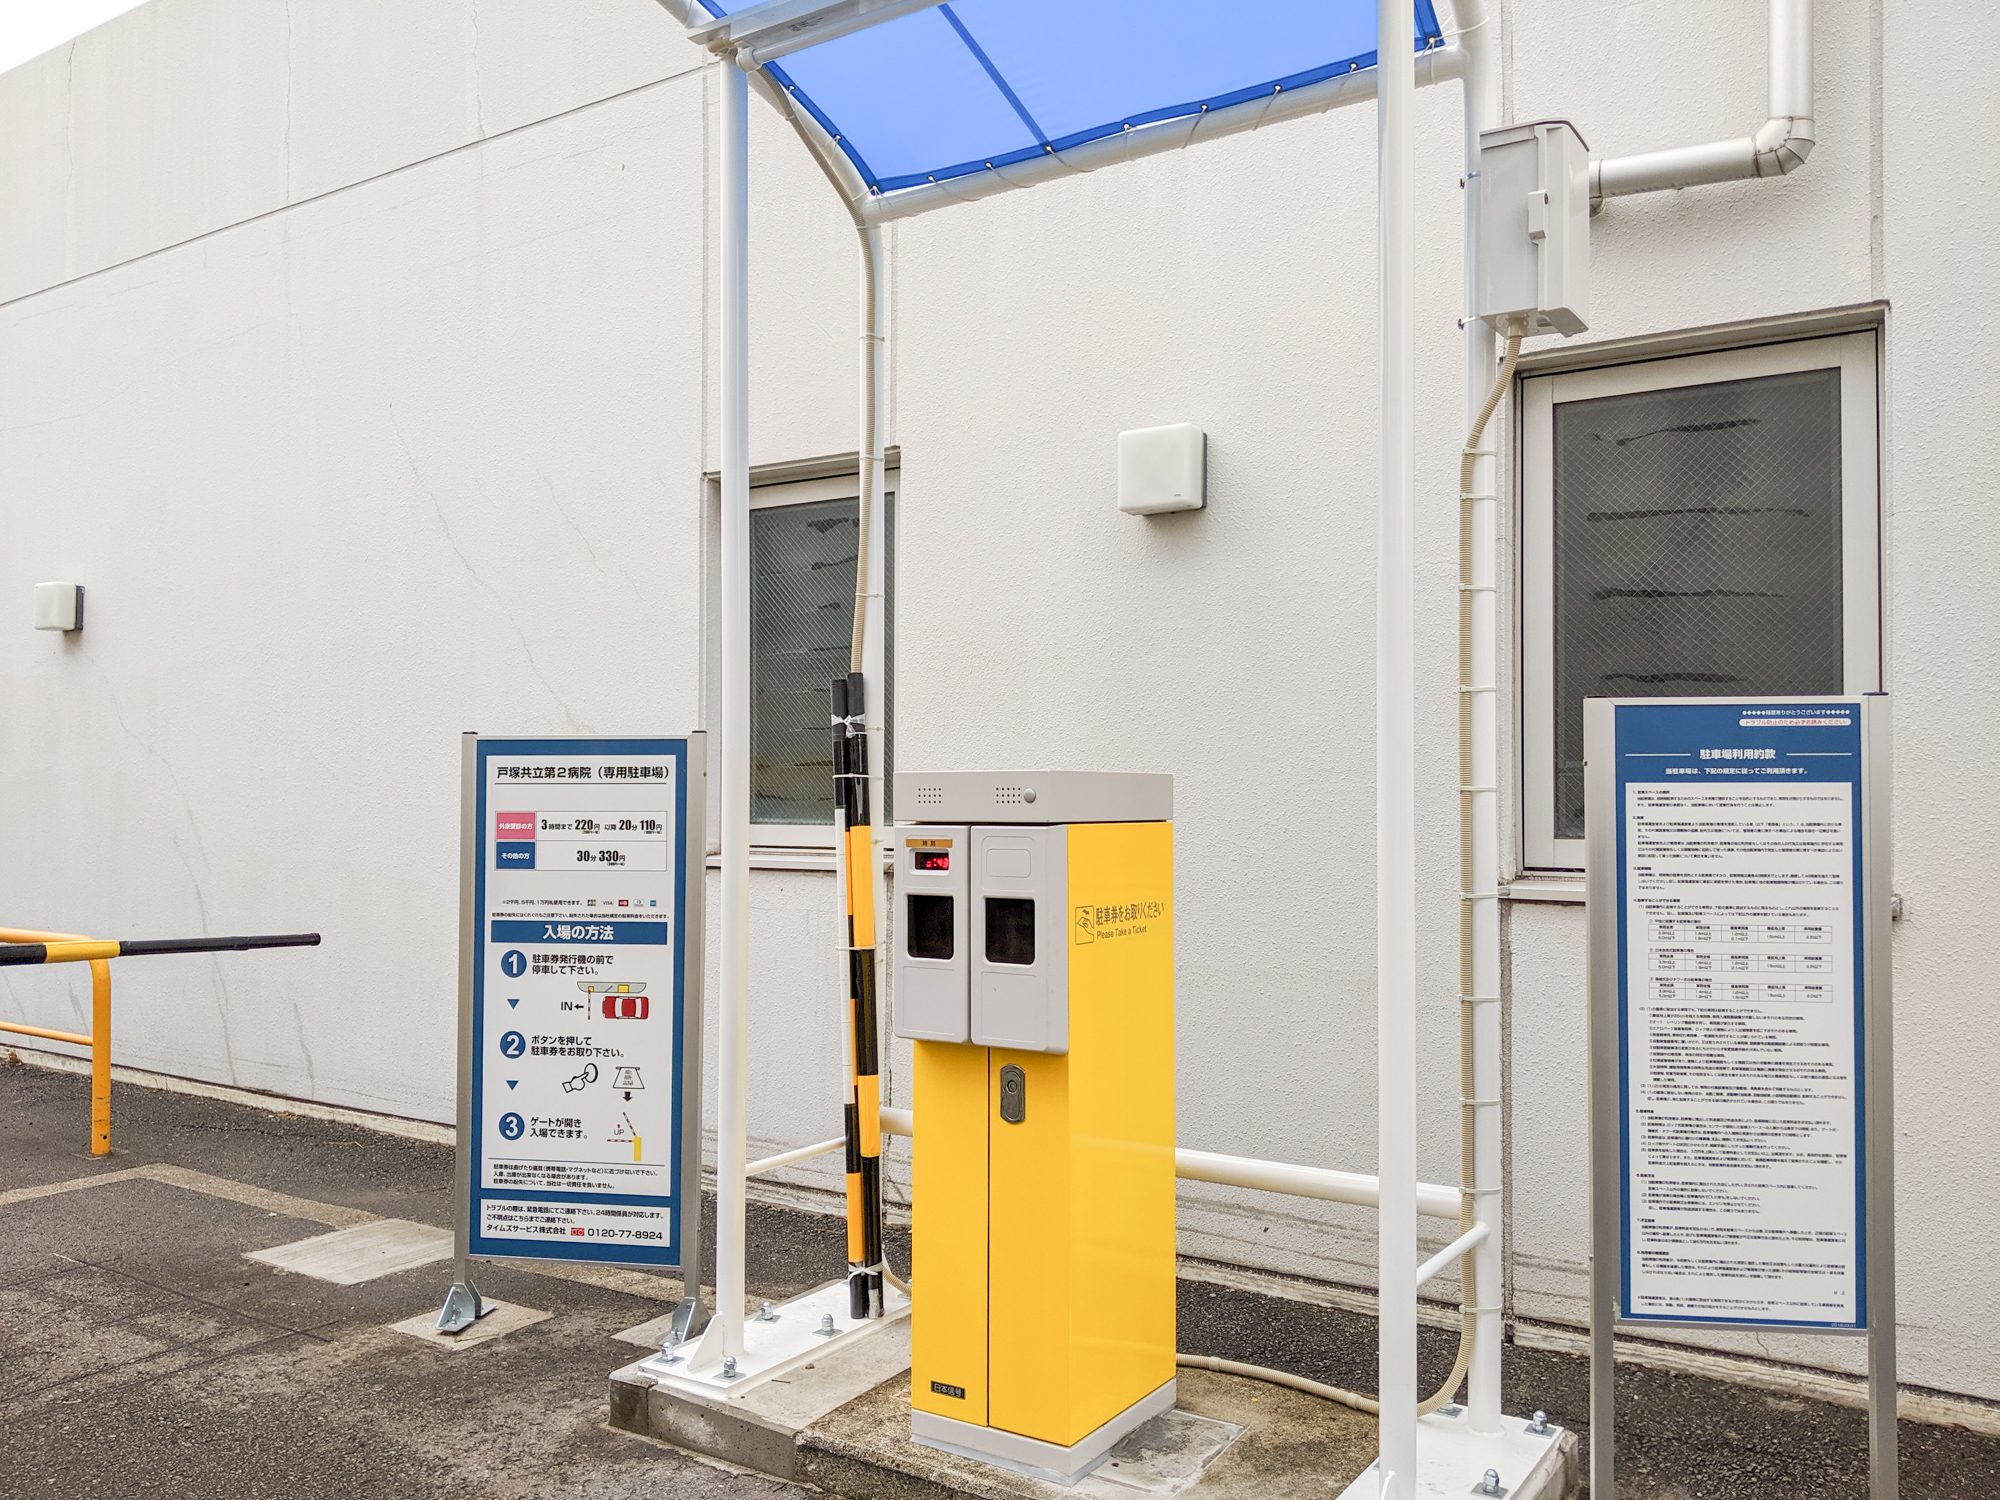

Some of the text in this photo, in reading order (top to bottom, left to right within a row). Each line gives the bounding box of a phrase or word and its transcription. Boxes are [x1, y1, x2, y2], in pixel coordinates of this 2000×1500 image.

[1700, 748, 1775, 760] 駐車場利用約款
[574, 820, 600, 830] 220円
[618, 820, 638, 830] 20分
[640, 820, 662, 831] 110円
[576, 850, 626, 862] 30分 330円
[1096, 901, 1165, 926] 駐車券をお取りください
[542, 924, 614, 940] 入場の方法
[1096, 930, 1114, 940] Please
[1115, 928, 1127, 937] Take
[1132, 925, 1147, 934] Ticket
[508, 954, 519, 974] 1
[532, 954, 614, 965] 駐車券発行機の前で
[532, 965, 599, 976] 停車して下さい。
[561, 1002, 573, 1011] IN
[506, 1035, 520, 1055] 2
[532, 1036, 592, 1046] ボタンを押して
[531, 1046, 624, 1058] 駐車券をお取り下さい。
[504, 1116, 518, 1136] 3
[530, 1117, 582, 1128] ゲートが開き
[530, 1128, 588, 1139] 入場できます。
[486, 1224, 566, 1235] タイムズサービス株式会社
[588, 1228, 663, 1240] 0120-77-8924
[934, 1382, 962, 1398] 日本信号
